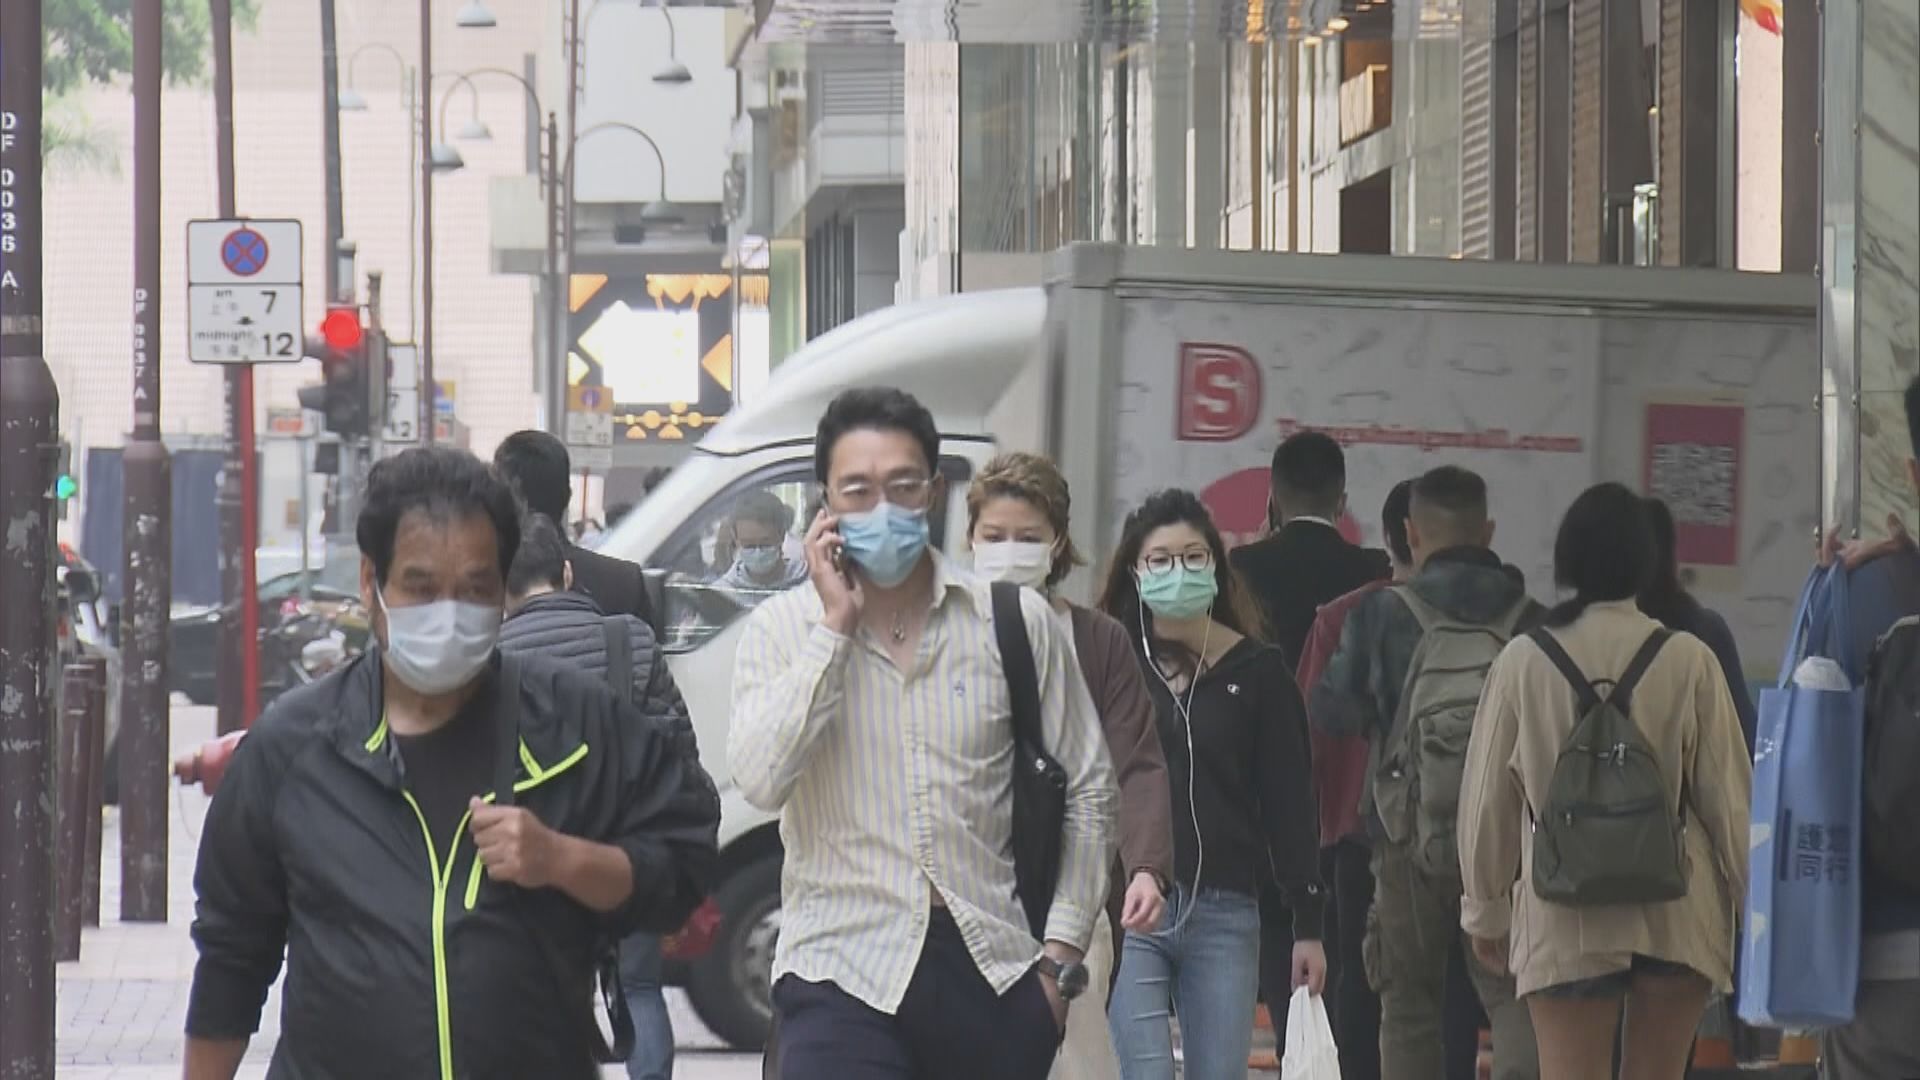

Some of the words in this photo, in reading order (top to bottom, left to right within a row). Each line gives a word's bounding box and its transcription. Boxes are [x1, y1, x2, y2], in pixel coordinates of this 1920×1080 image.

[1, 111, 17, 150] DF
[260, 289, 278, 314] 7
[262, 331, 294, 356] 12
